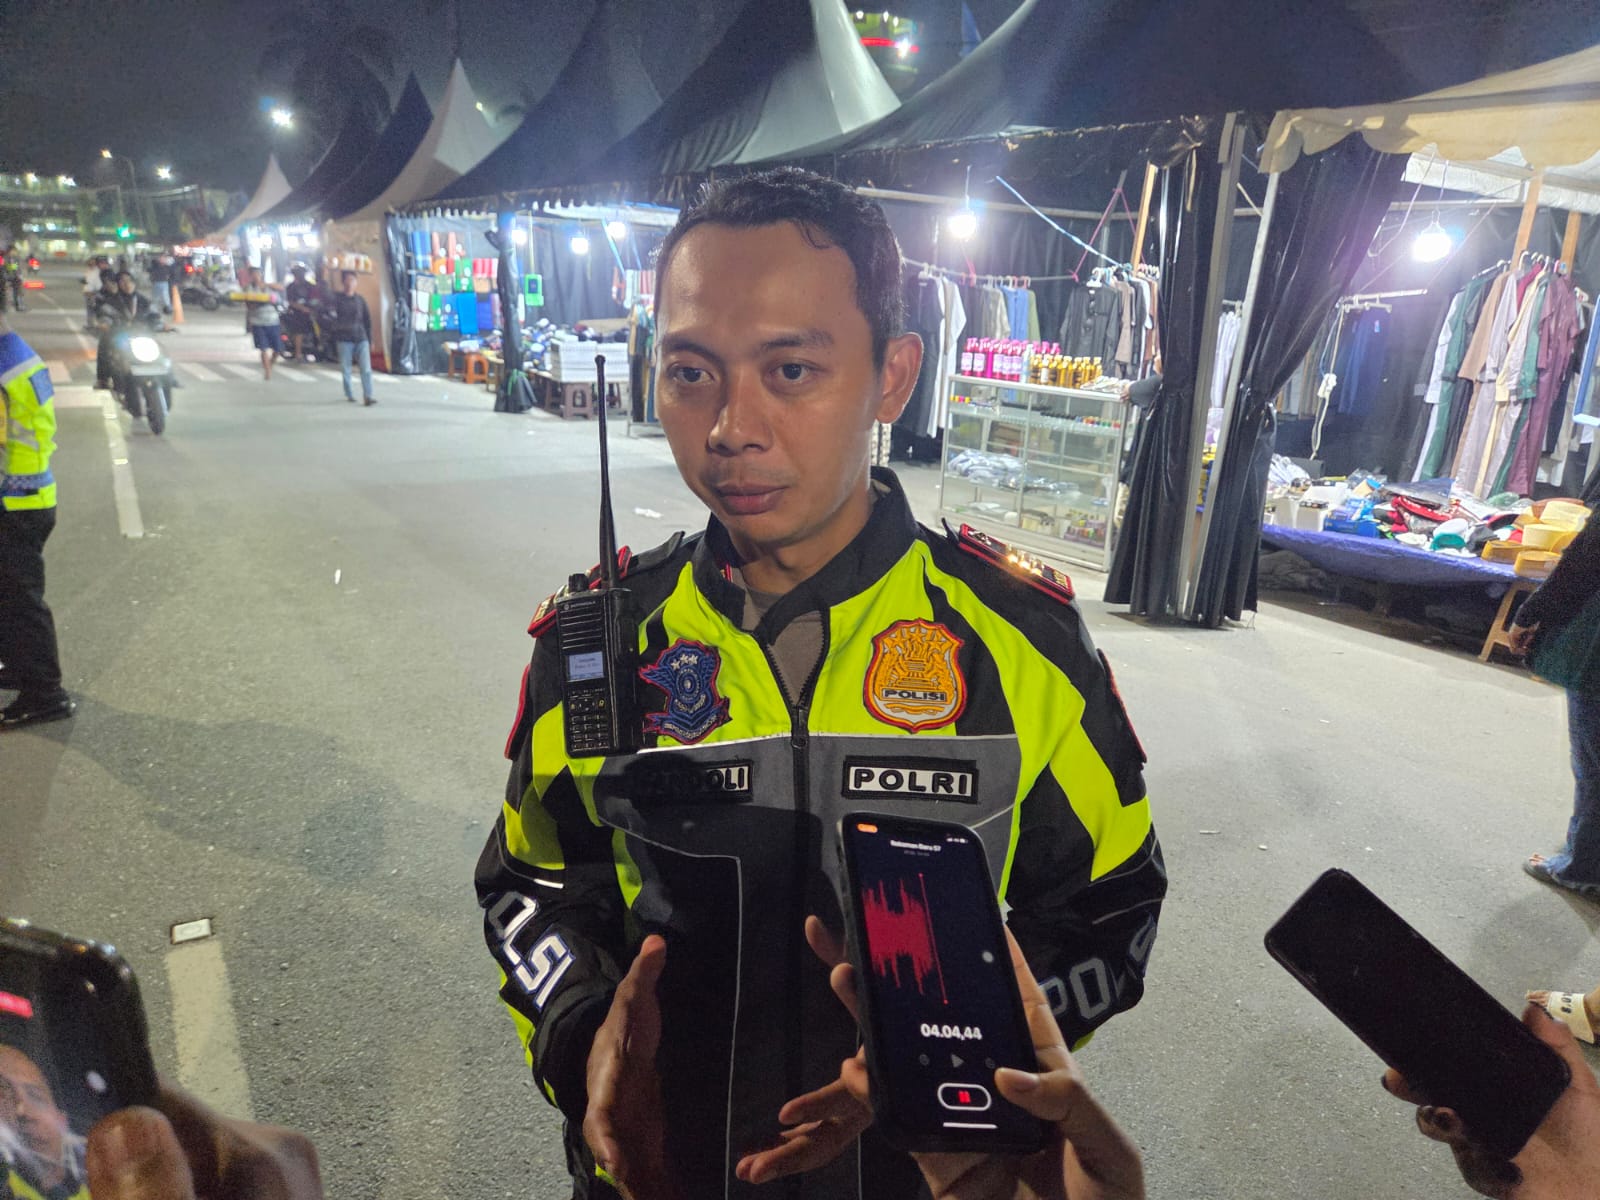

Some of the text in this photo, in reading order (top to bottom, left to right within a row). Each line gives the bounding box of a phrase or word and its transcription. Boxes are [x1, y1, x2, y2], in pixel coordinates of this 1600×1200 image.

[884, 690, 946, 701] POLISI
[854, 769, 967, 795] POLRI
[920, 1023, 983, 1041] 04.04,44
